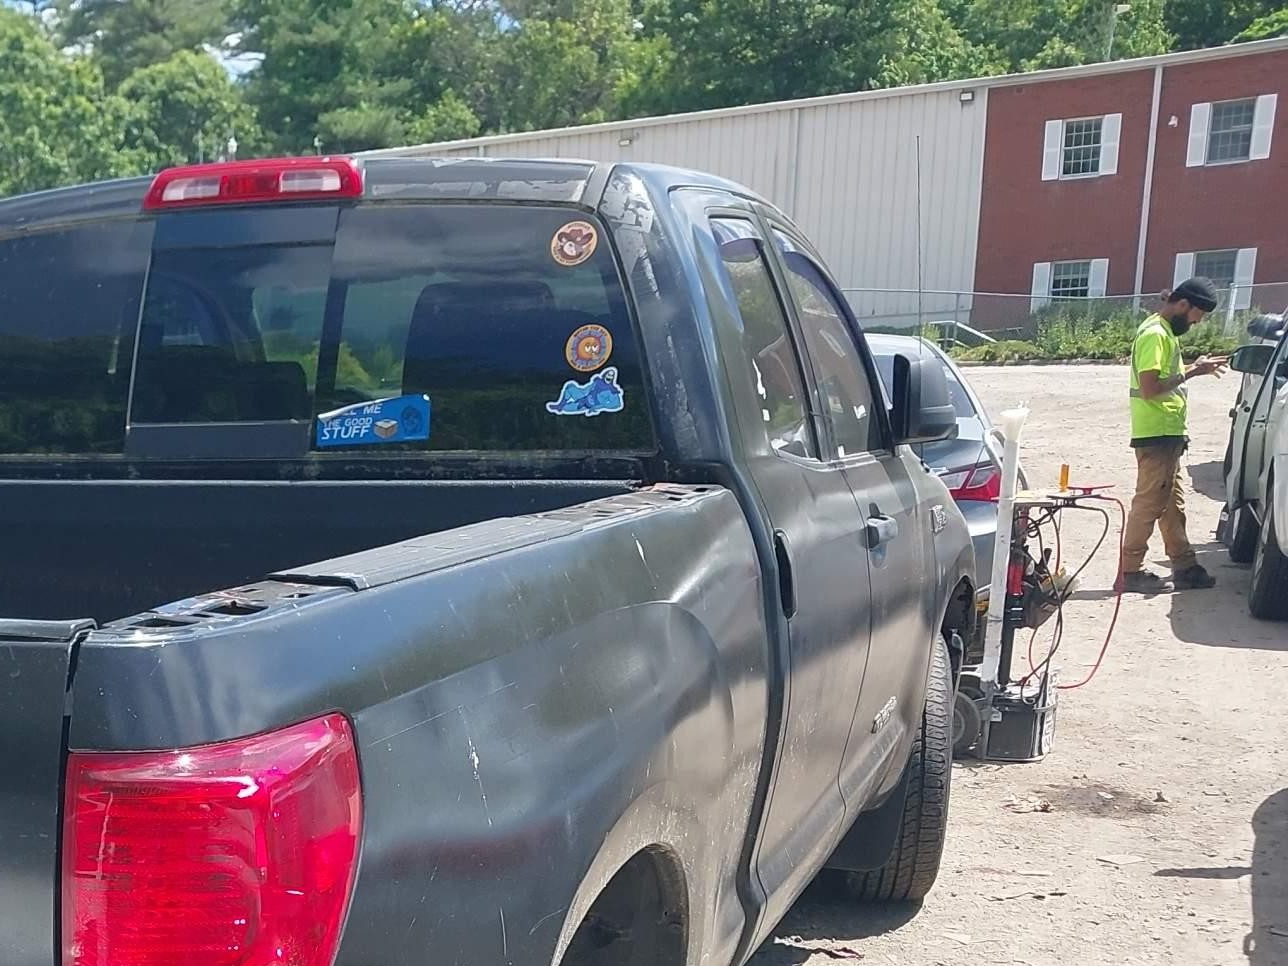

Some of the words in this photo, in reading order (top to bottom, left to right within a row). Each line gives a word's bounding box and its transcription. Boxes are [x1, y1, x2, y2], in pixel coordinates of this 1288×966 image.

[363, 403, 383, 415] ME
[344, 417, 372, 426] GOOD
[321, 425, 370, 440] STUFF
